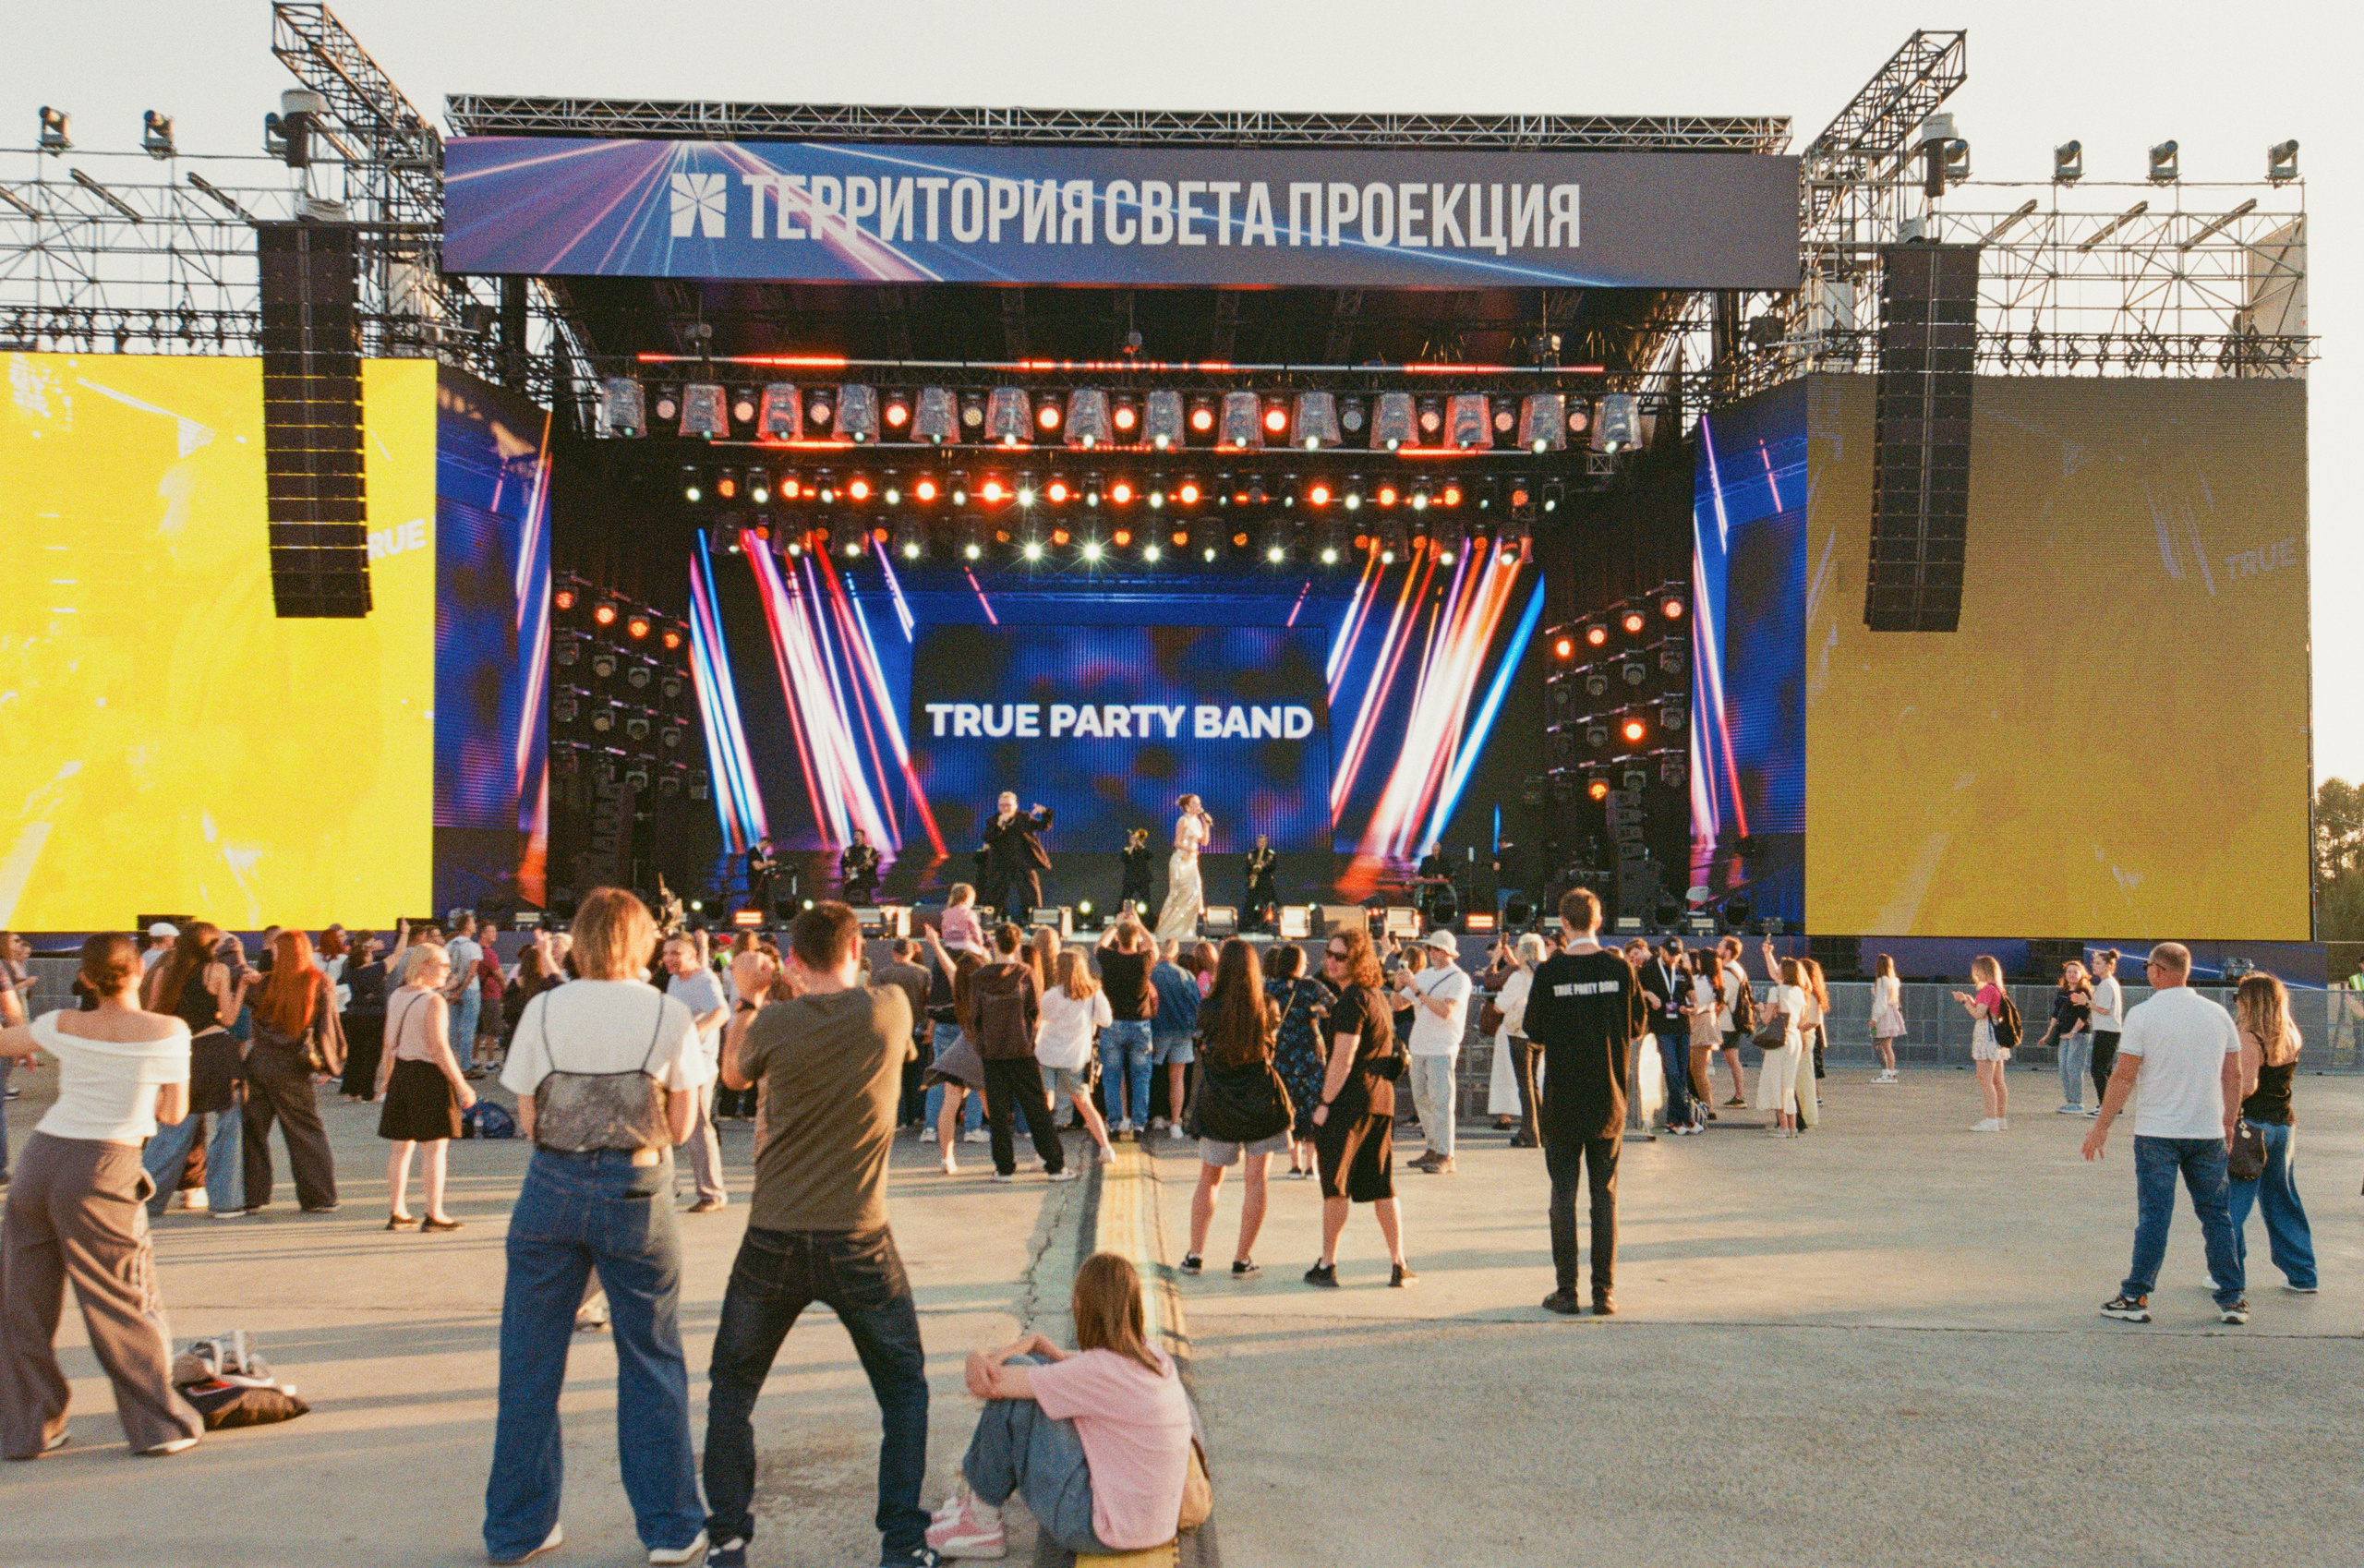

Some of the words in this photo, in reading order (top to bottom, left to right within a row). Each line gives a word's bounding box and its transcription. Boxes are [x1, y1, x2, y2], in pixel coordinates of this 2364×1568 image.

[742, 175, 1093, 244] ТЕРРИТОРИЯ
[1104, 180, 1276, 247] СВЕТА
[1289, 182, 1580, 256] ПРОЕКЦИЯ
[368, 518, 427, 561] RUE
[2225, 537, 2297, 581] TRUE
[925, 704, 1040, 737] TRUE
[1050, 705, 1187, 738] PARTY
[1194, 706, 1313, 739] BAND
[1553, 983, 1574, 996] TRUE
[1574, 983, 1598, 995] PARTY
